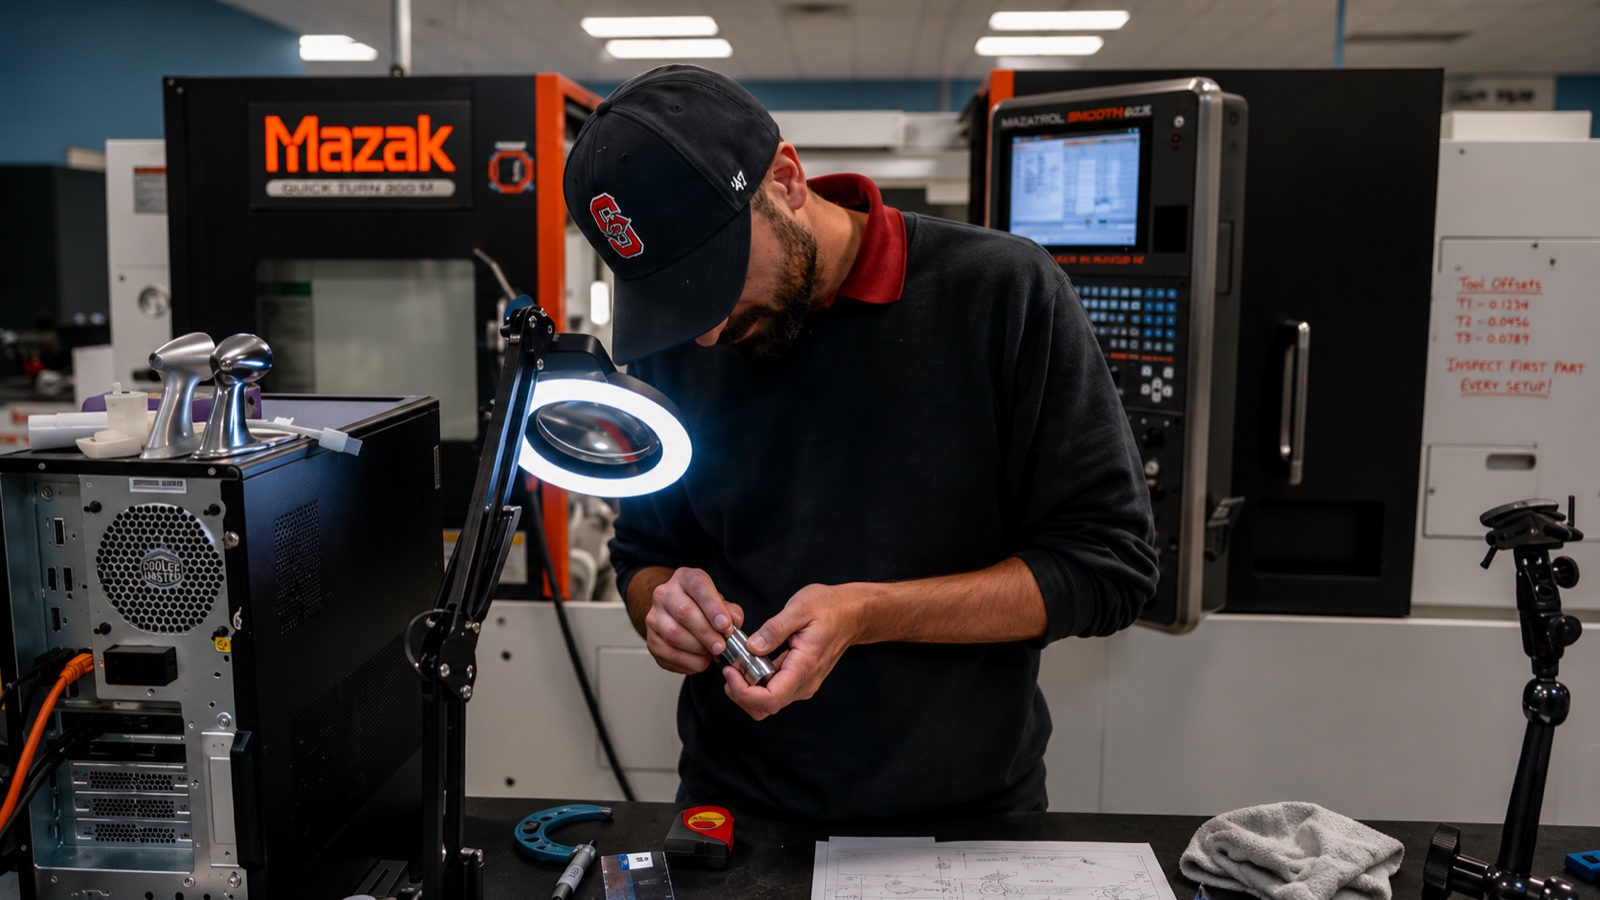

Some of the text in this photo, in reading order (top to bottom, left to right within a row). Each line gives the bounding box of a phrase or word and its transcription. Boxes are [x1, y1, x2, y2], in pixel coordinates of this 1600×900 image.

[1001, 113, 1065, 128] MAZATROL
[1067, 106, 1124, 123] SMOOTH
[264, 114, 456, 173] Mazak
[282, 183, 331, 194] QUICK
[338, 183, 381, 194] TURN
[1458, 275, 1542, 292] Tool Offsets
[1457, 297, 1472, 310] T1
[1488, 299, 1529, 311] 0.1234
[1456, 315, 1472, 327] T2
[1487, 316, 1530, 328] 0.0456
[1455, 332, 1472, 344] T3
[1486, 333, 1530, 345] 0.0789
[1446, 357, 1587, 374] INSPECT FIRST PART
[1460, 377, 1552, 394] EVERY SETUP!
